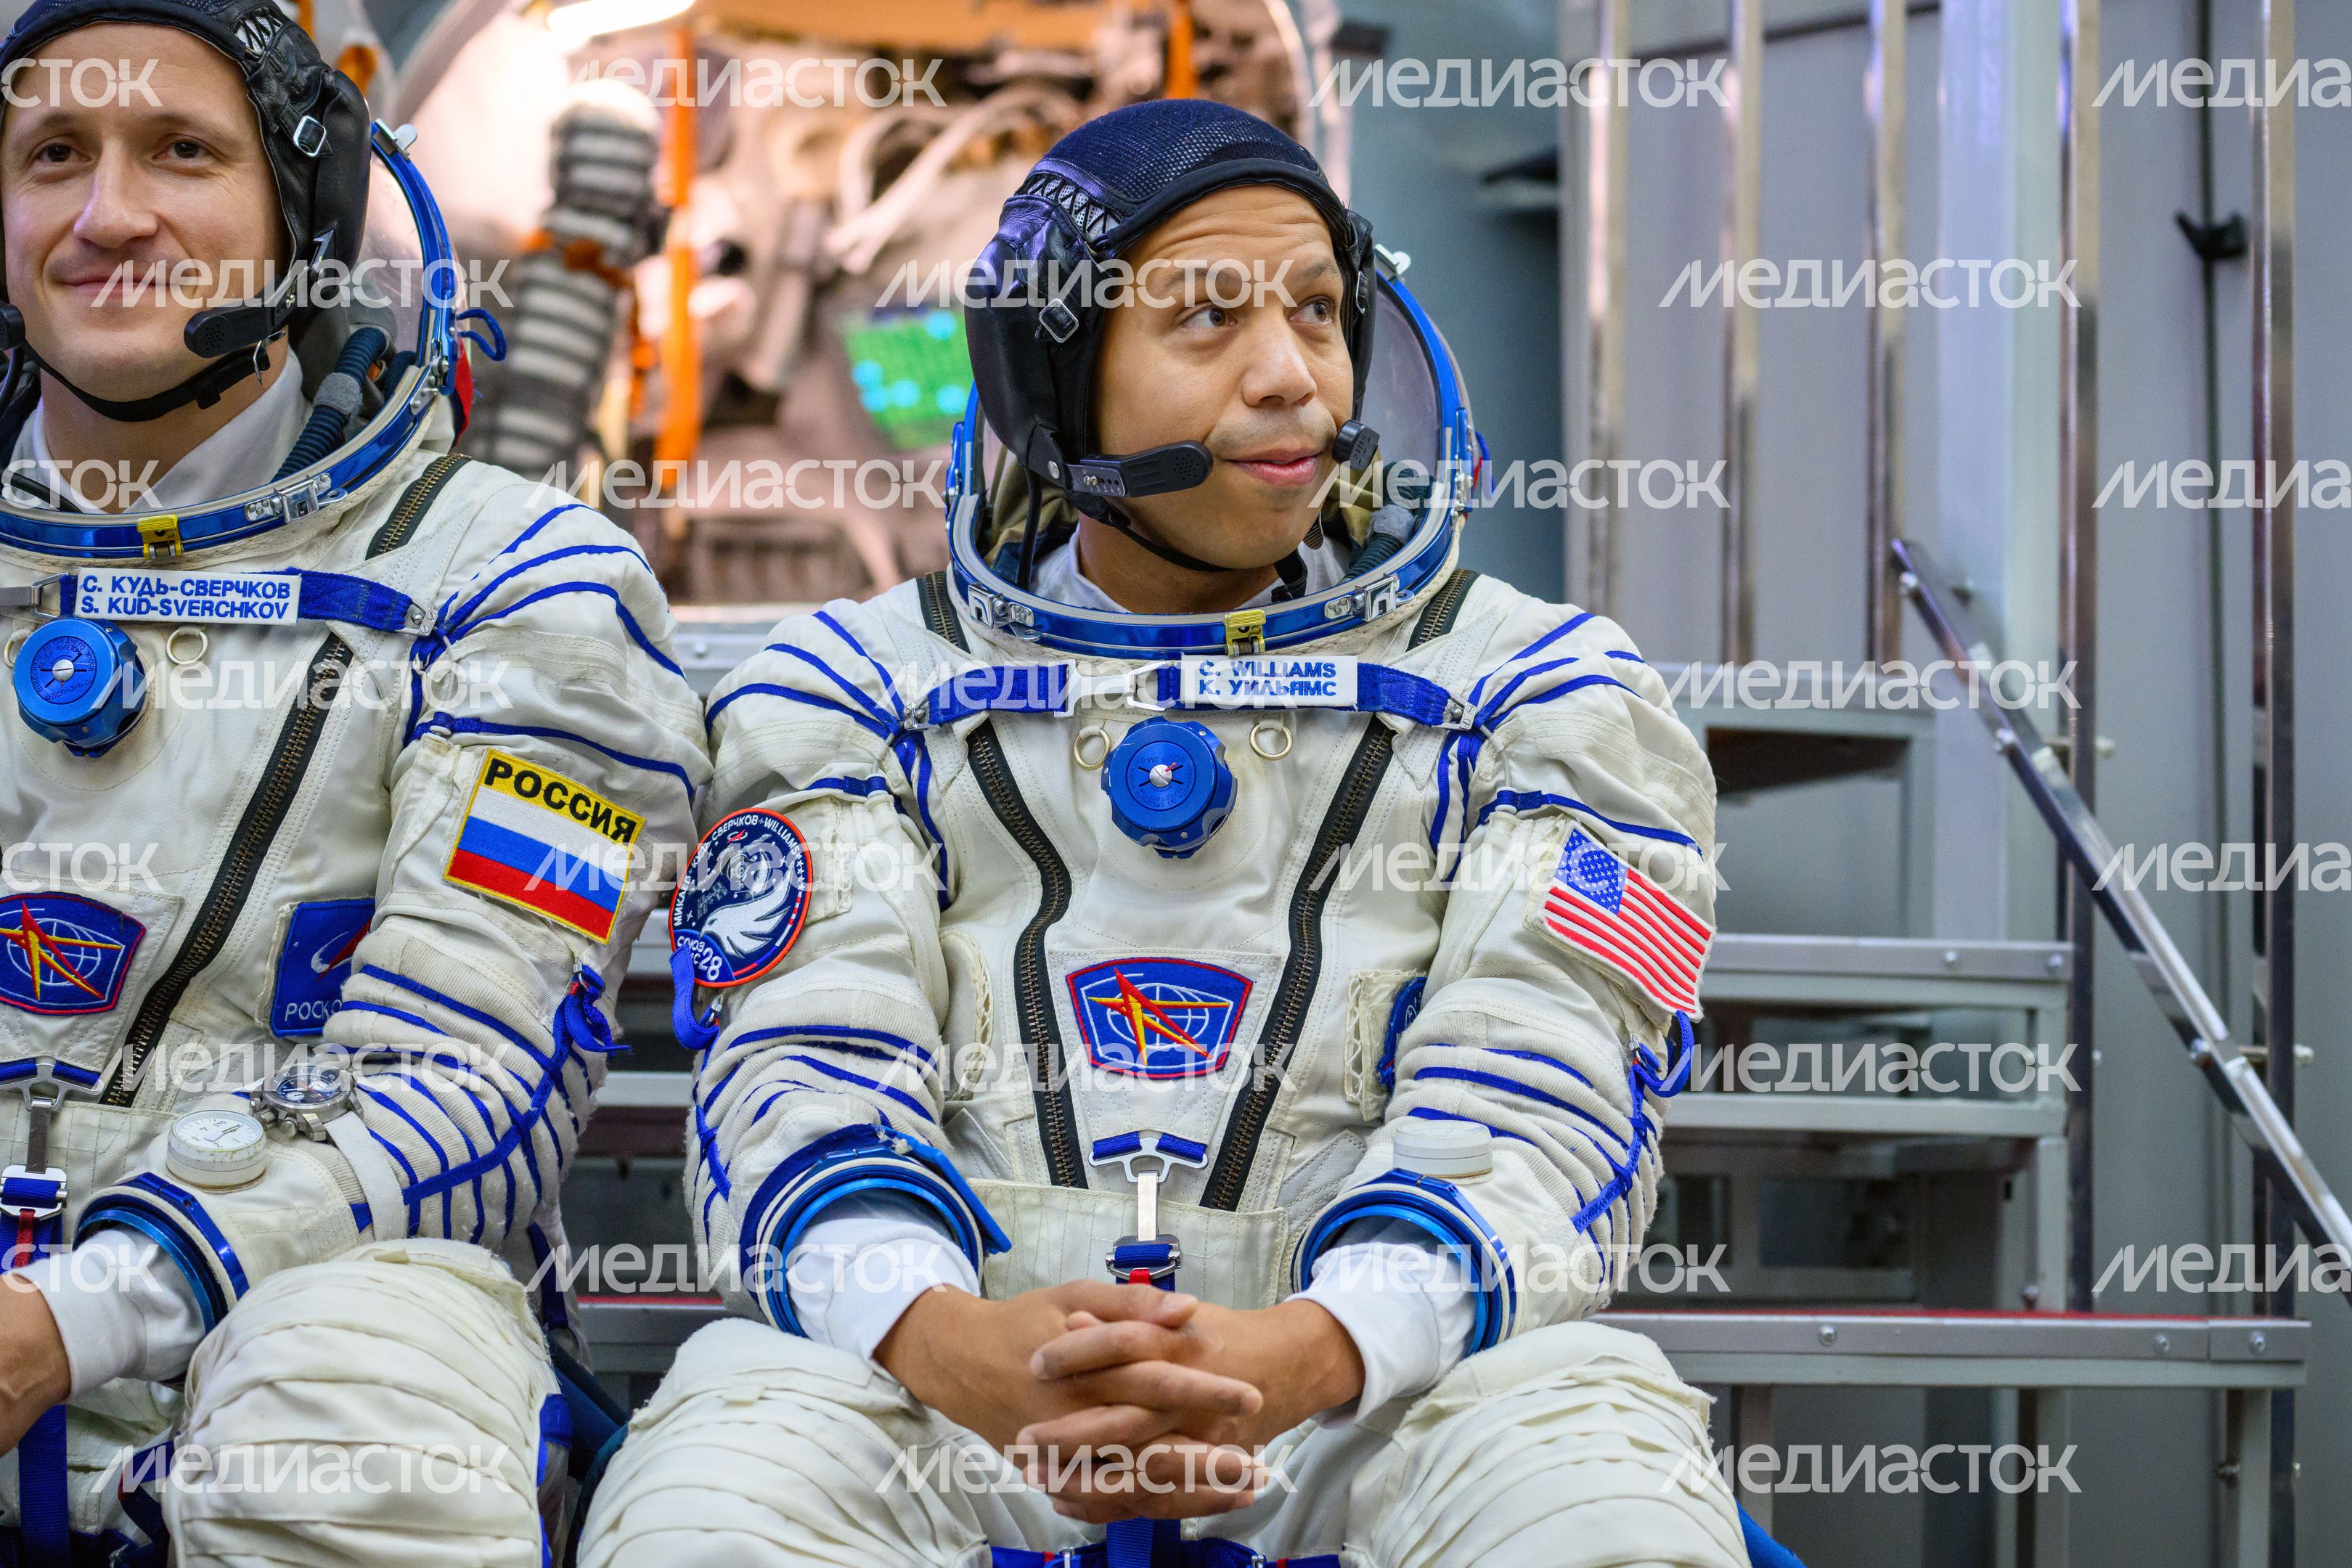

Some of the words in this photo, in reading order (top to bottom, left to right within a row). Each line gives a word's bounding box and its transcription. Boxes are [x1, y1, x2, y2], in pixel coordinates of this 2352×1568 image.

[111, 576, 290, 600] КУДЬ-СВЕРЧКОВ
[81, 595, 99, 613] S.
[107, 597, 290, 618] KUD-SVERCHKOV
[1199, 661, 1221, 677] C.
[1231, 661, 1336, 677] WILLIAMS
[1228, 679, 1336, 696] УИЛЬЯМС
[484, 758, 637, 843] РОССИЯ
[764, 817, 801, 855] WILLIAMS
[674, 874, 692, 927] МИКАЕВ
[699, 947, 723, 981] 28
